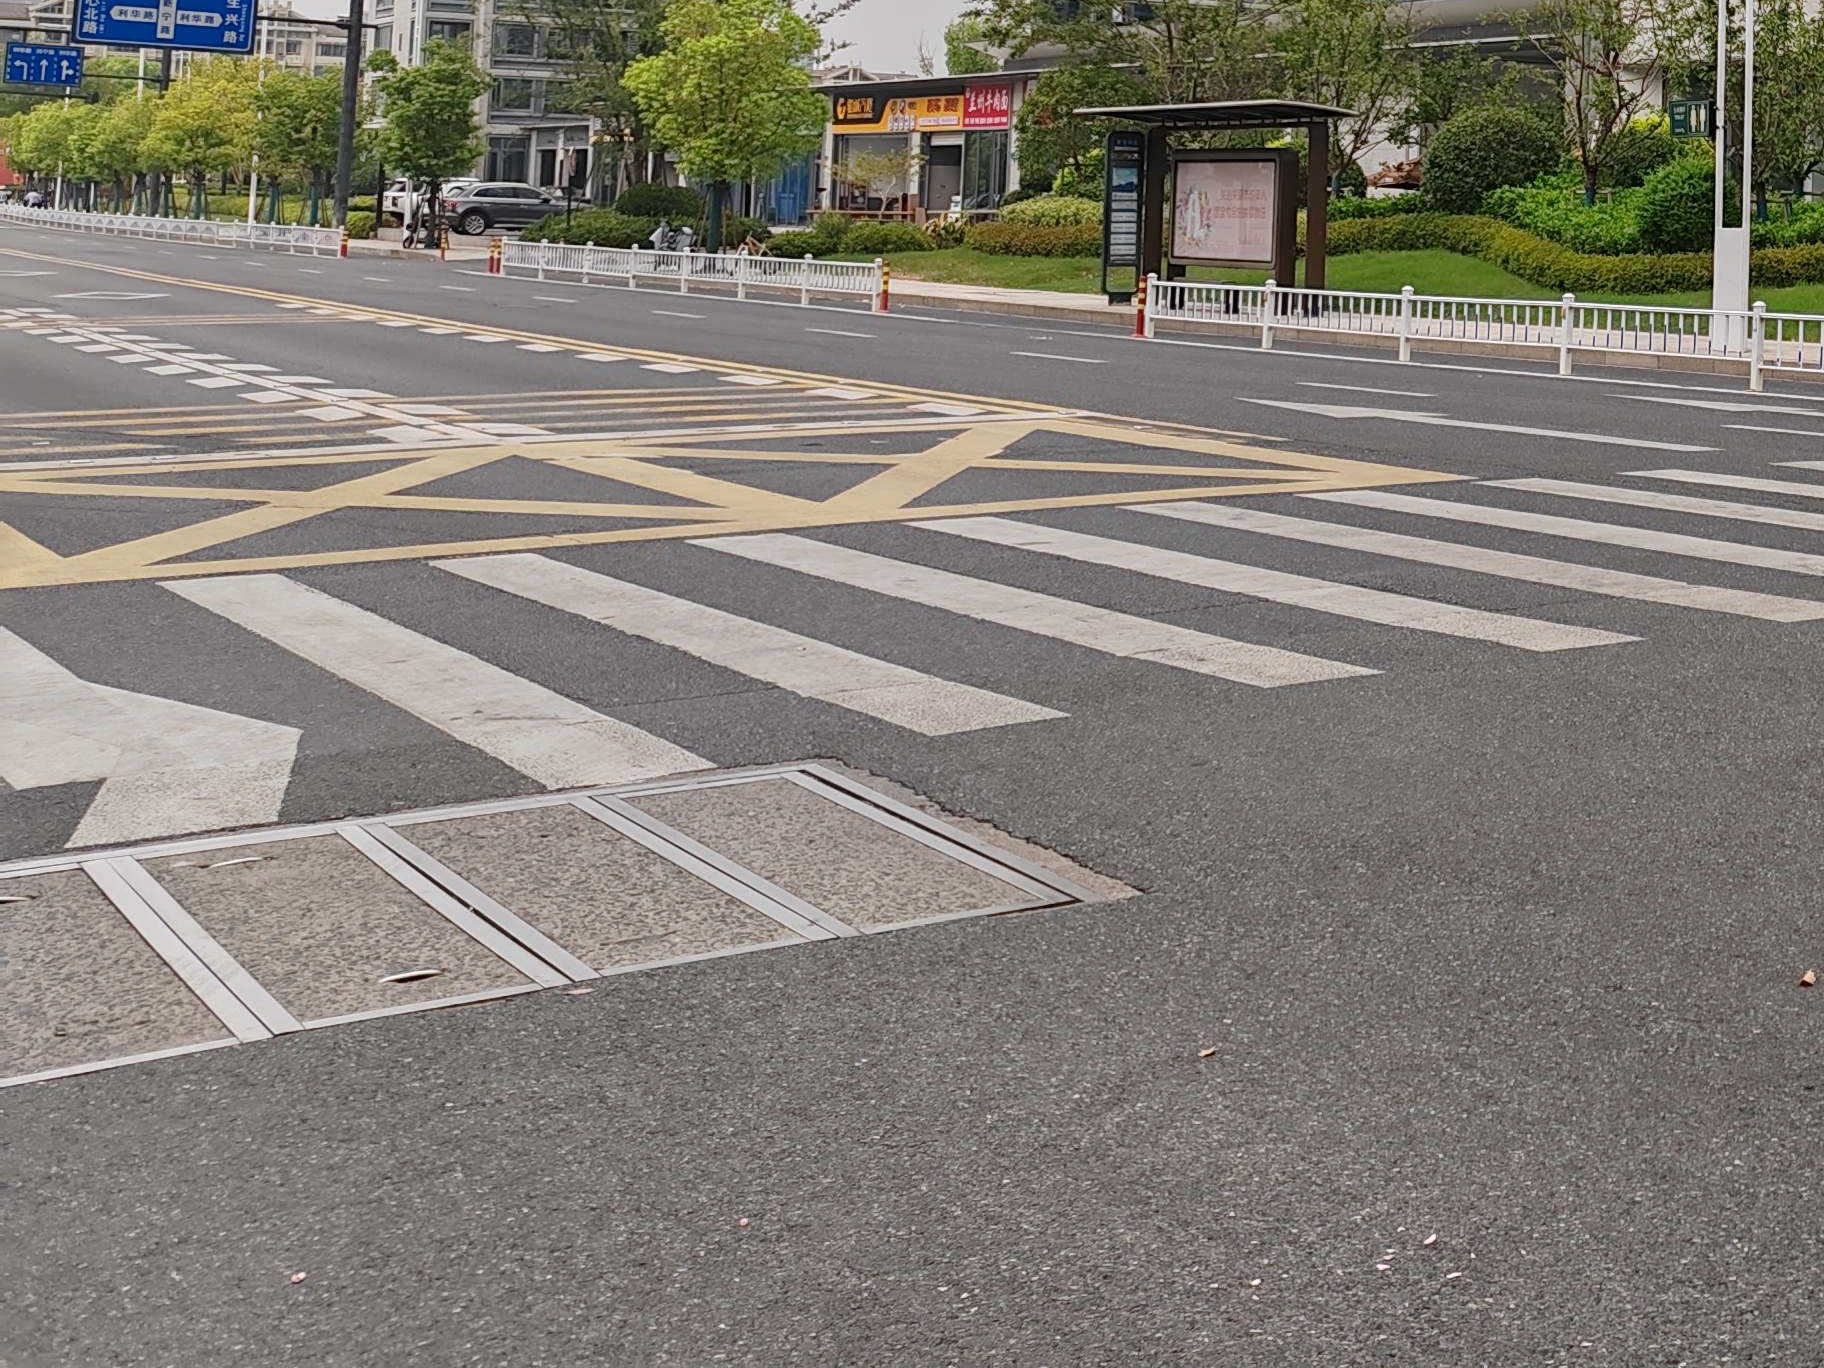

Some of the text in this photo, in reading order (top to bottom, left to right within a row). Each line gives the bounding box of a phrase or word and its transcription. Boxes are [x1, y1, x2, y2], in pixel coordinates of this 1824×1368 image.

[117, 8, 155, 21] 利华路
[179, 13, 216, 25] 利华路
